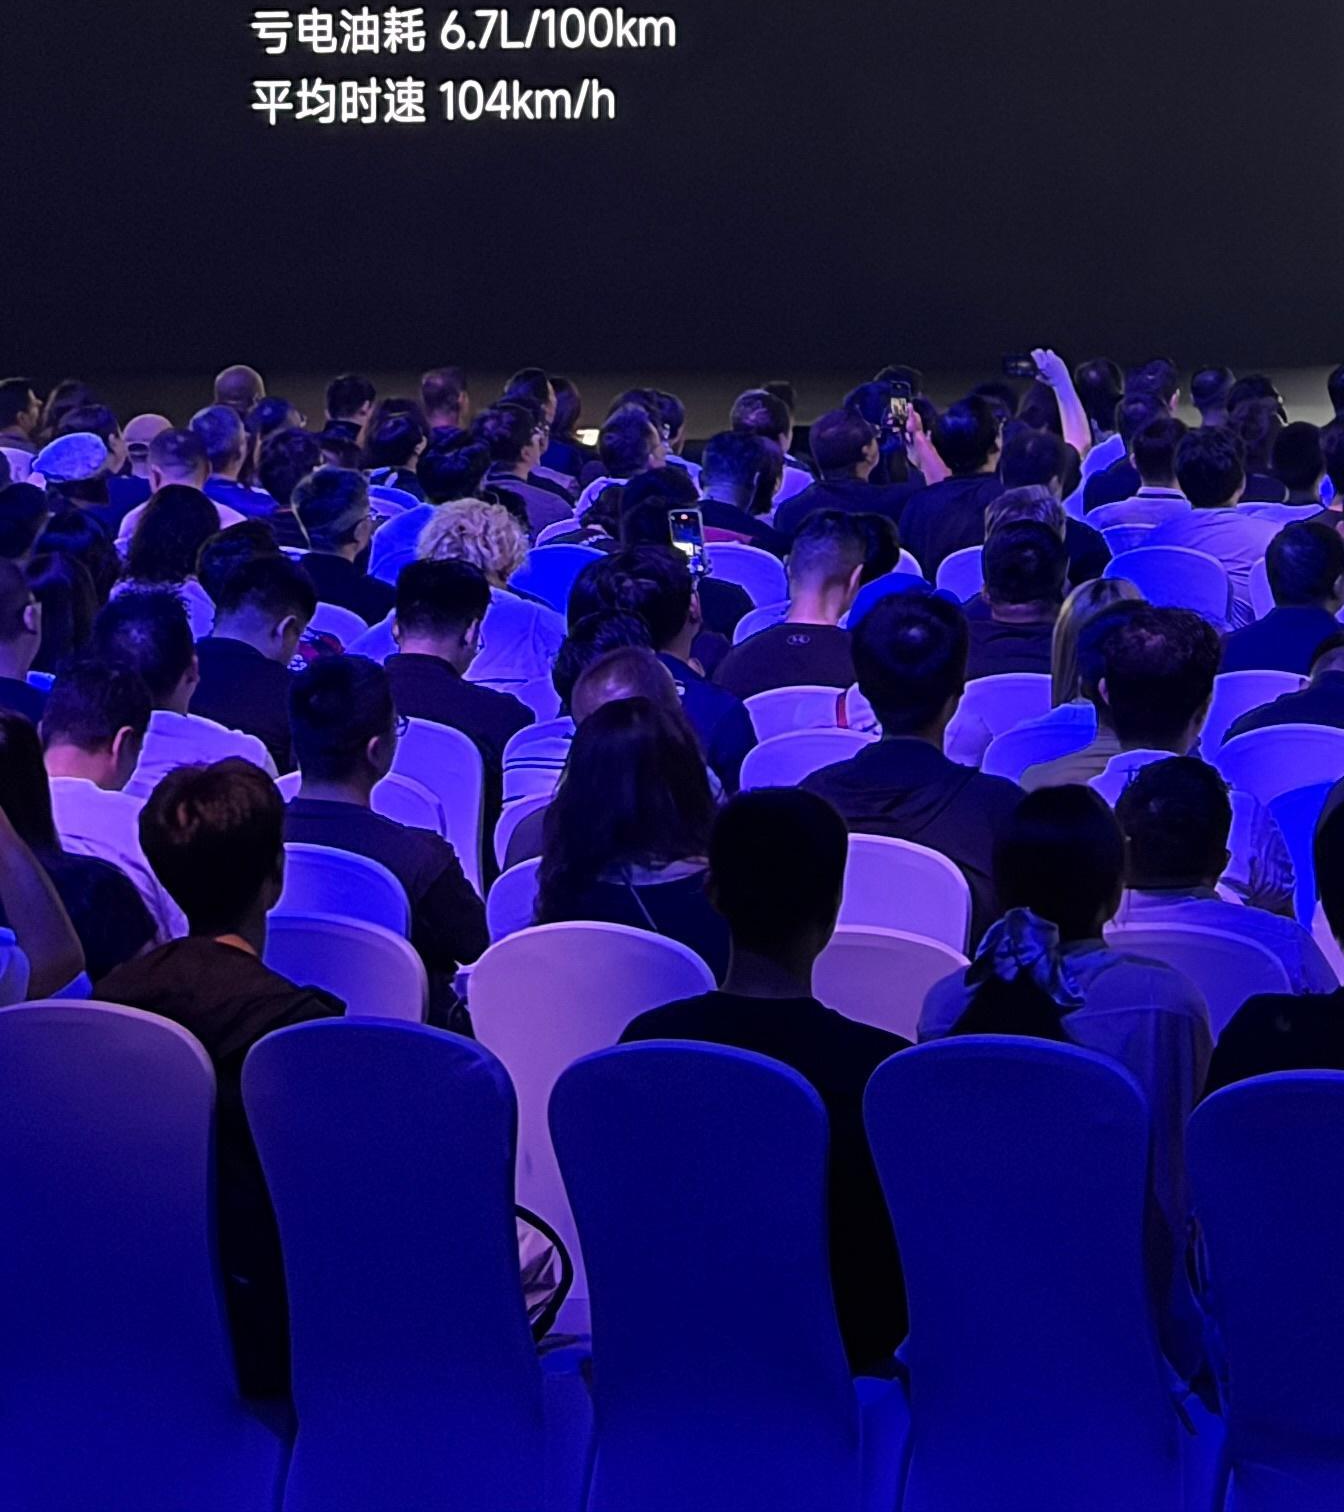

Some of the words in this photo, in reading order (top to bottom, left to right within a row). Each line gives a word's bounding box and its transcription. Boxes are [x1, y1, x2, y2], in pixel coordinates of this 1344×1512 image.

[250, 6, 427, 55] 亏电油耗
[440, 7, 676, 50] 6.7L/100km
[251, 75, 426, 126] 平均时速
[439, 78, 615, 121] 104km/h
